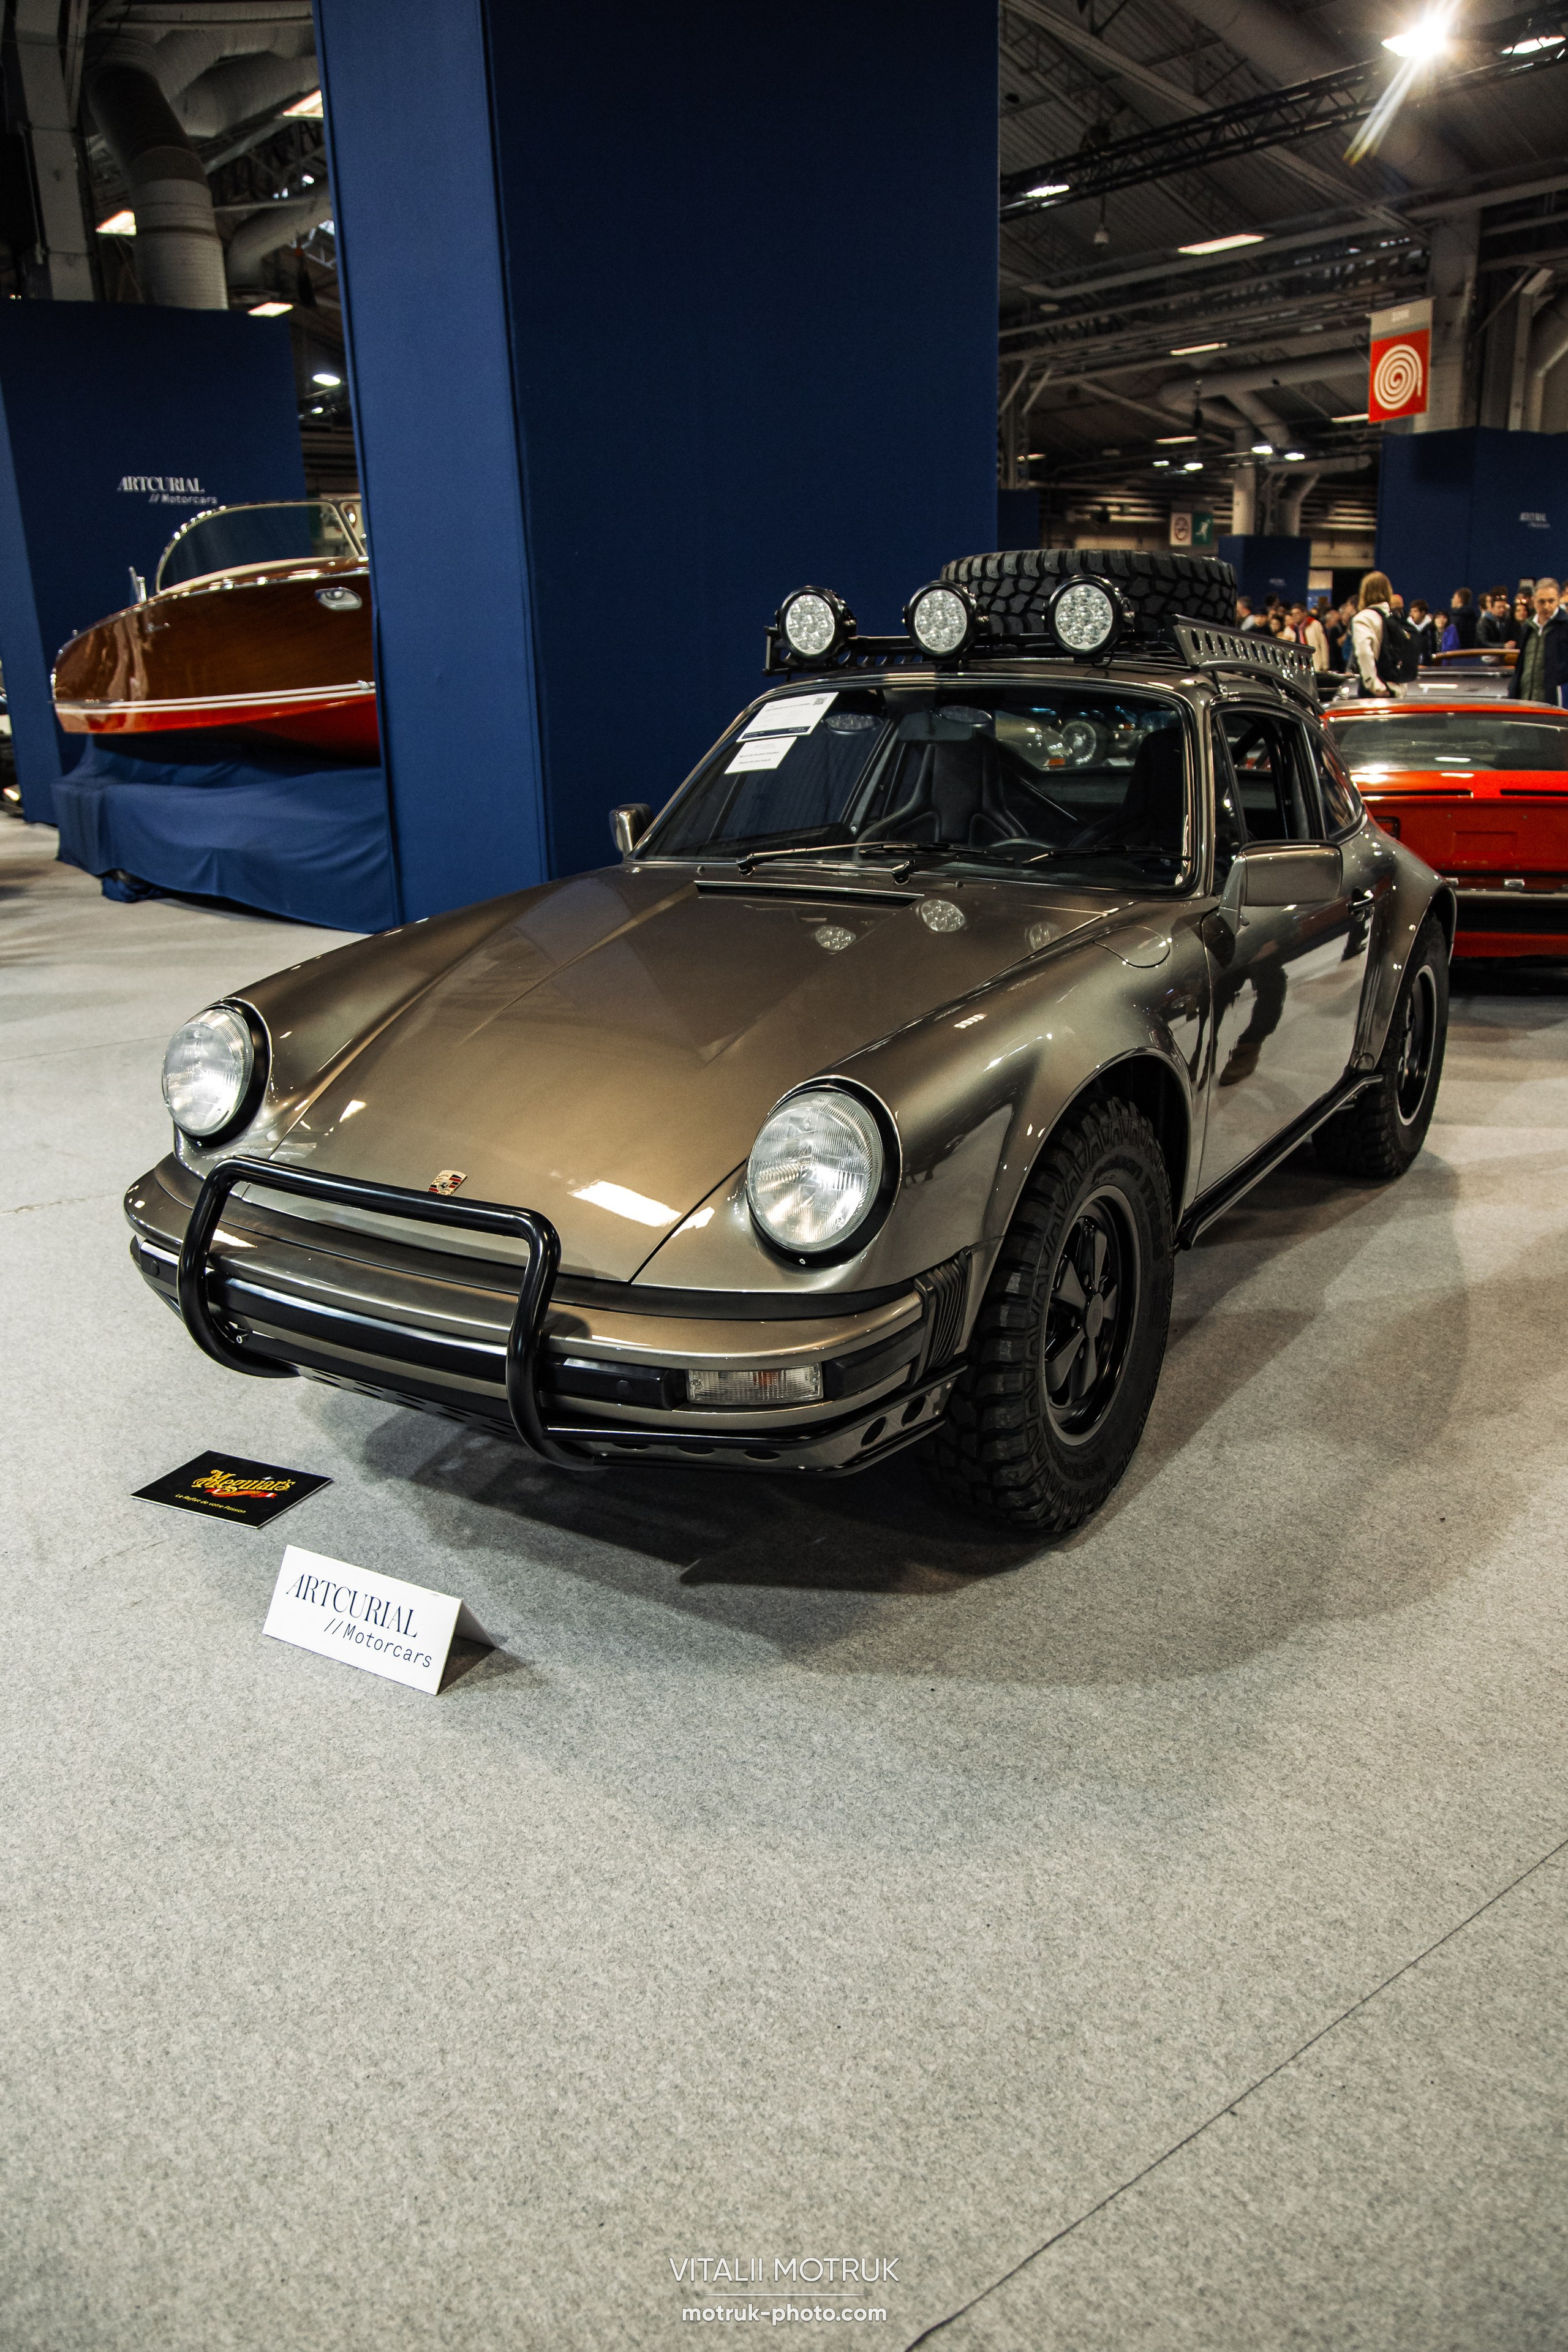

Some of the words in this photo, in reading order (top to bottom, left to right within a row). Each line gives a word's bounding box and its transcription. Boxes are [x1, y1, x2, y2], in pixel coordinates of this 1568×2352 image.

[116, 476, 206, 494] ARTCURIAL
[191, 1469, 296, 1496] Meguiar's
[224, 1505, 246, 1513] Passion
[285, 1574, 418, 1638] ARTCURIAL
